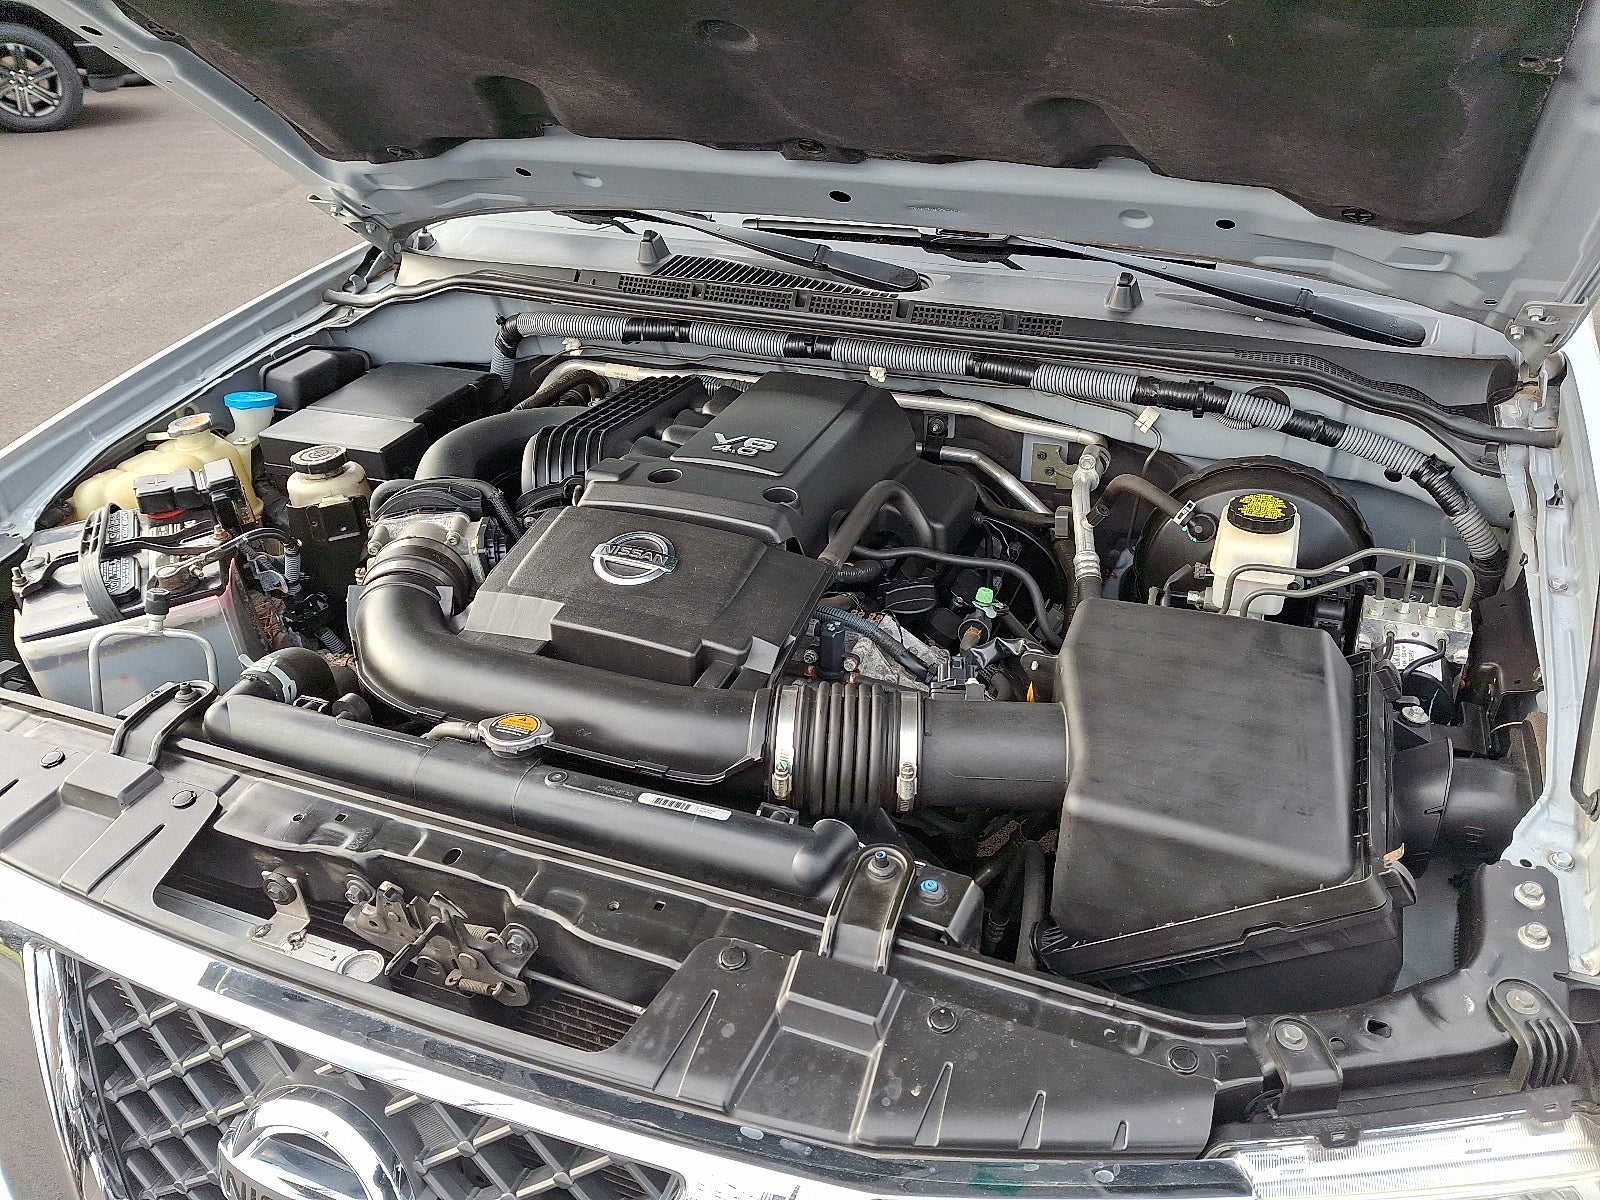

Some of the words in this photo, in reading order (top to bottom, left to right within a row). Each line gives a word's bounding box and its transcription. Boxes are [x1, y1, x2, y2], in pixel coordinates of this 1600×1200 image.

[711, 444, 759, 457] 4.0
[714, 432, 778, 452] V6
[600, 543, 669, 566] NISSAN
